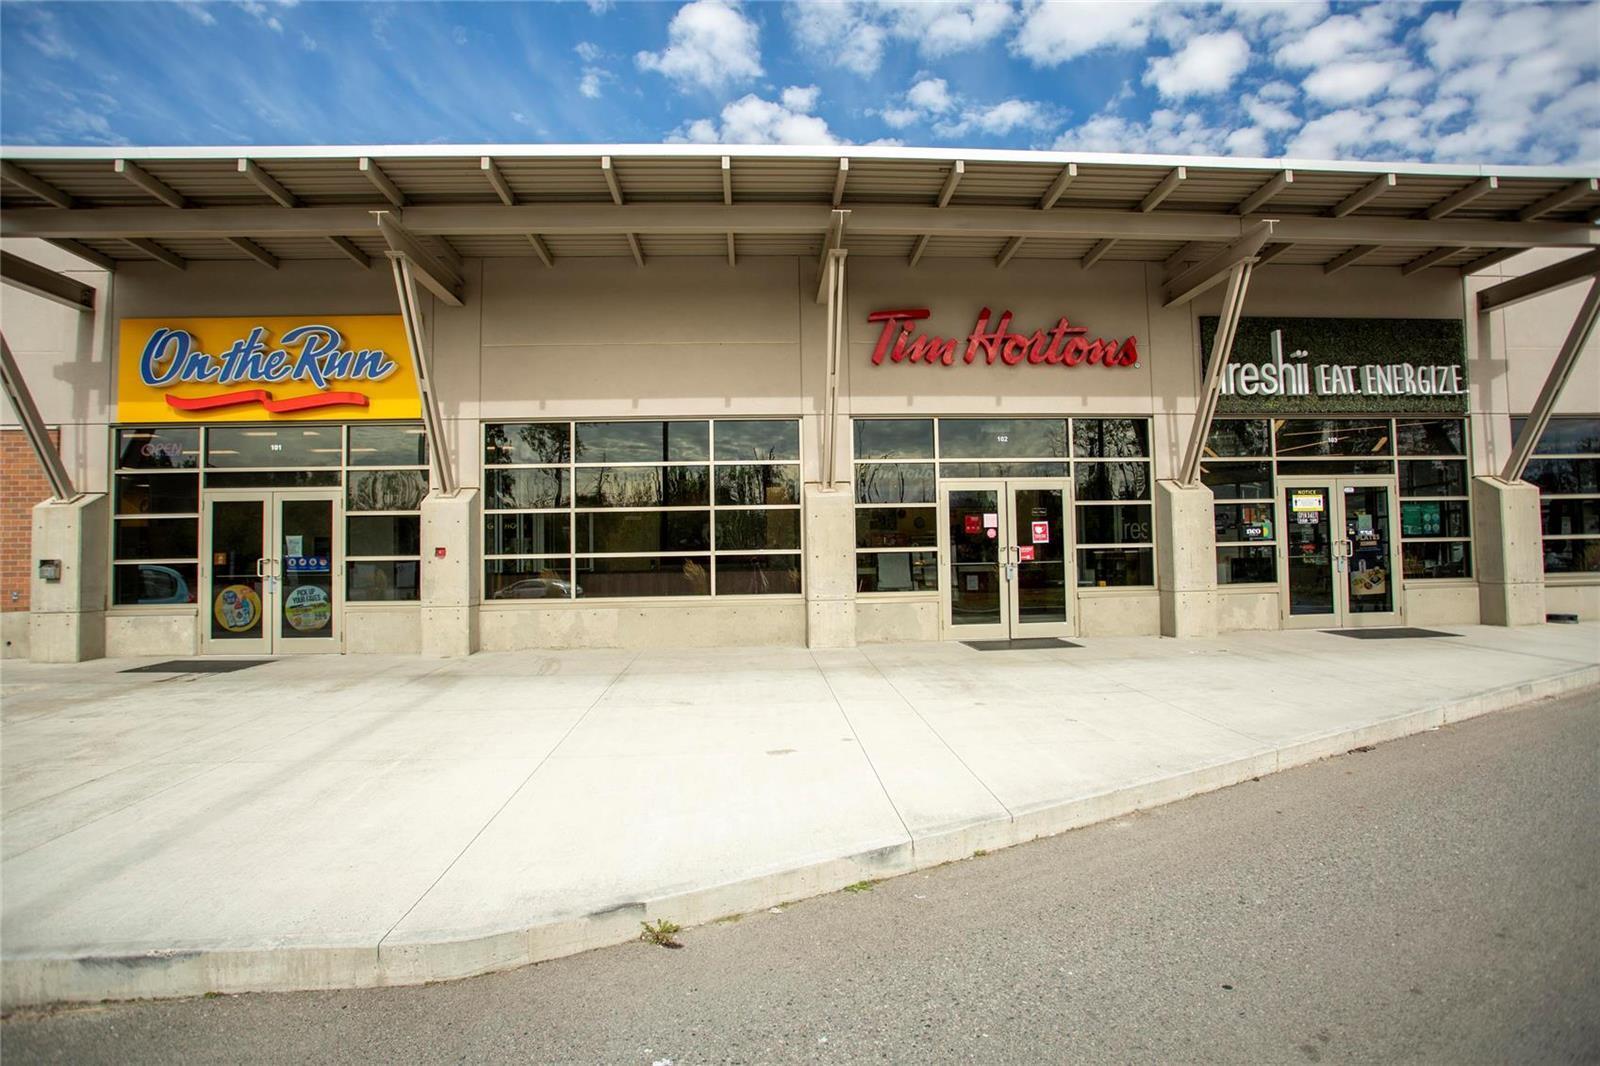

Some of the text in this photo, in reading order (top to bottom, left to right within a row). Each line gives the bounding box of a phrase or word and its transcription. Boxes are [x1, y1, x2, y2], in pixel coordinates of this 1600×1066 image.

[139, 325, 398, 390] On the Run
[868, 307, 1138, 367] Tim Hortons
